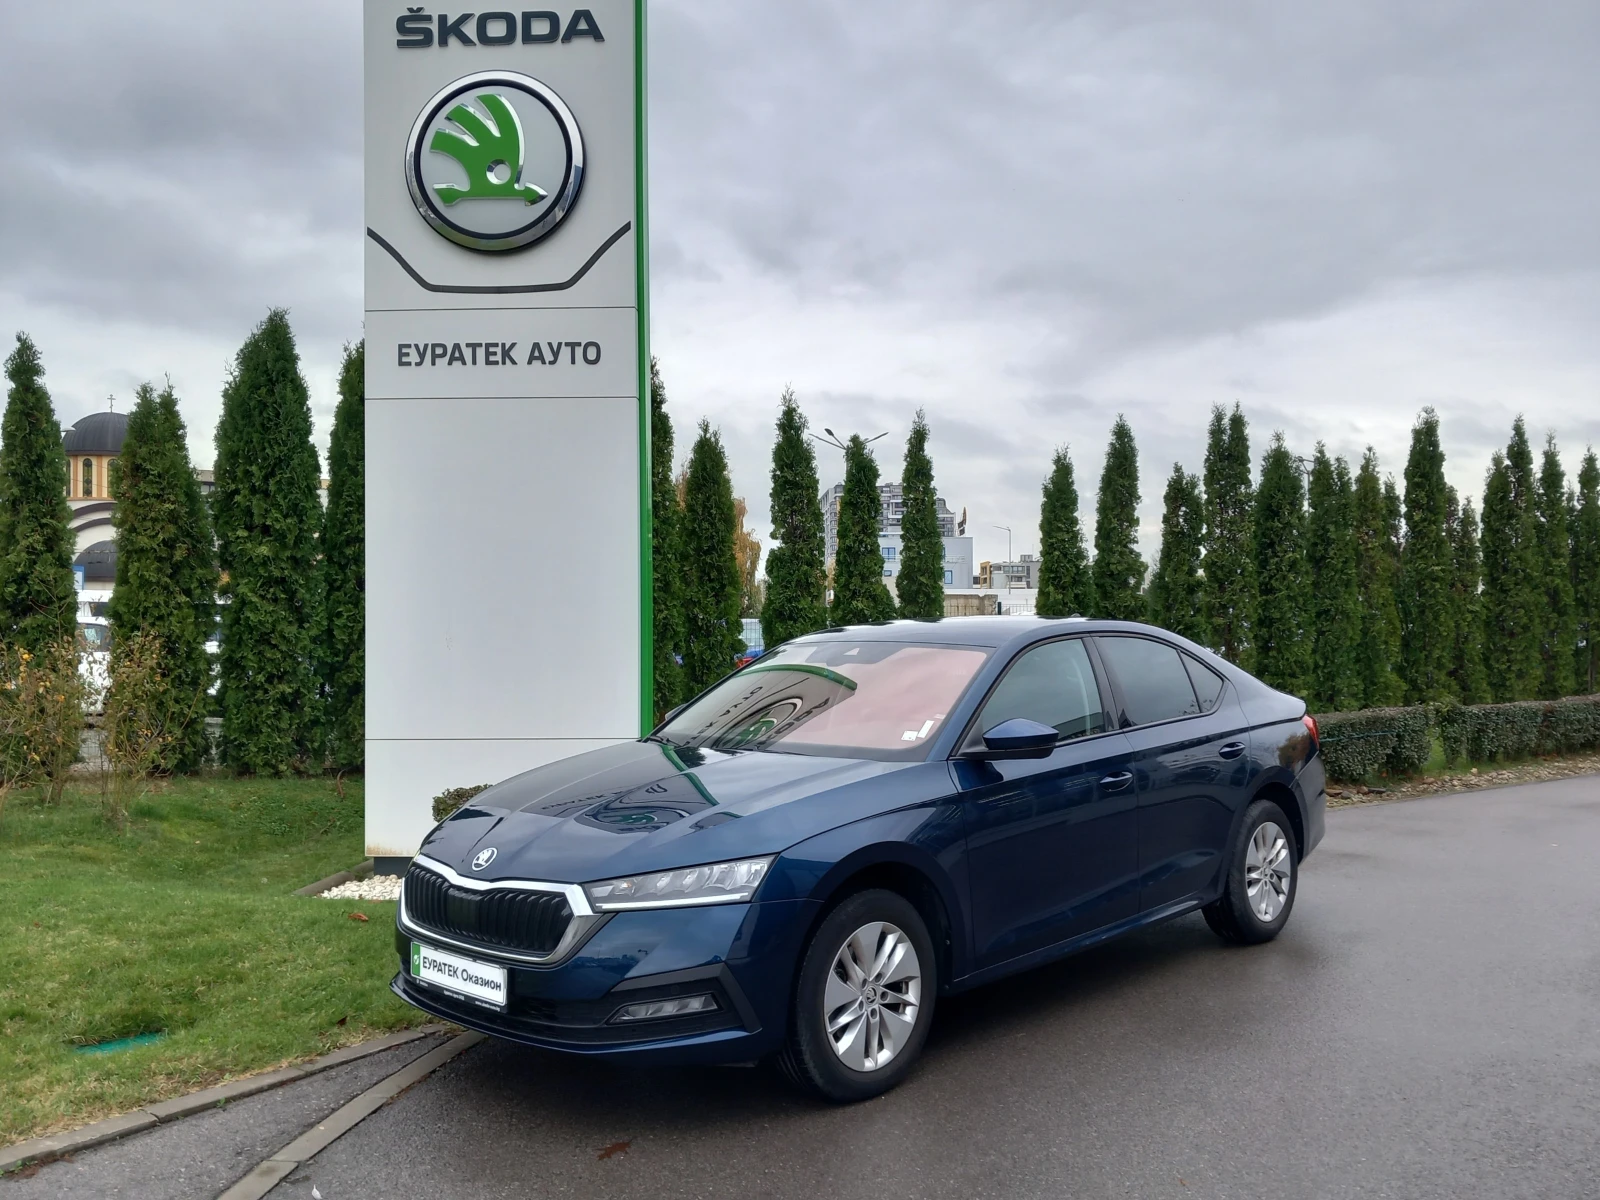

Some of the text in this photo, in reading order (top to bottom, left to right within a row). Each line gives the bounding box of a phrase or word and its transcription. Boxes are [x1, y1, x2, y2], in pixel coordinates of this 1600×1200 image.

[396, 7, 605, 48] ŠKODA
[397, 341, 601, 367] ЕУРАТЕК АУТО
[422, 956, 502, 992] ЕУРАТЕК Оказион
